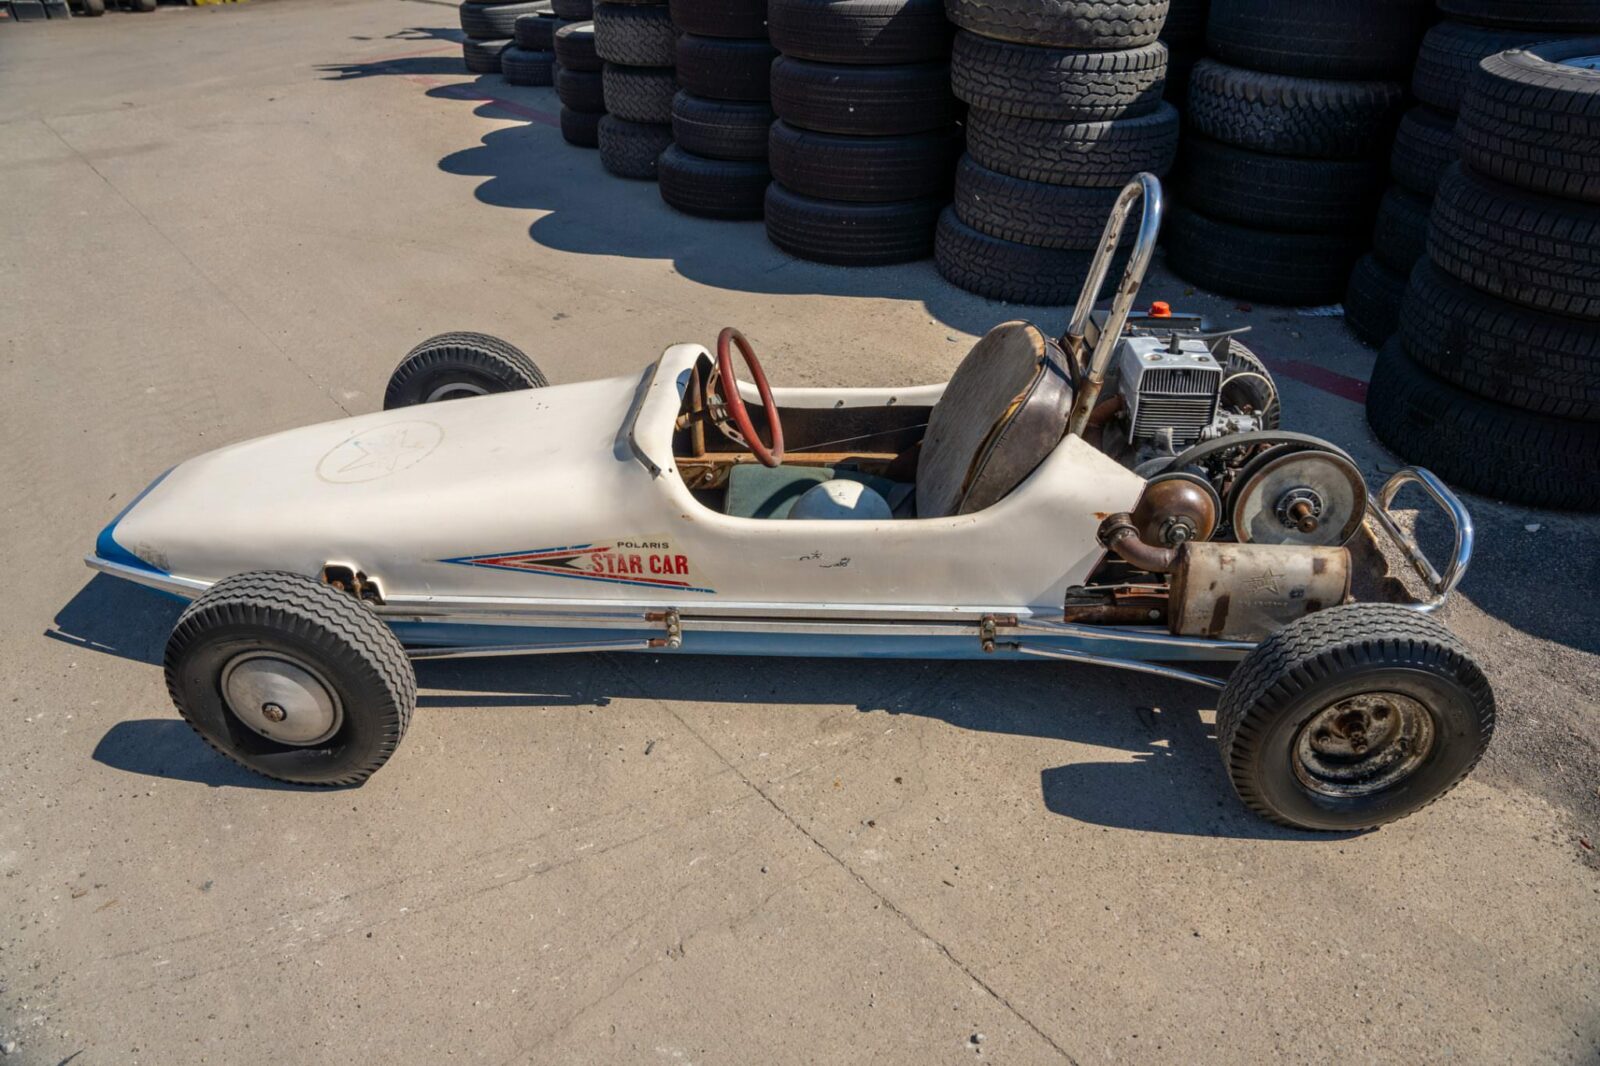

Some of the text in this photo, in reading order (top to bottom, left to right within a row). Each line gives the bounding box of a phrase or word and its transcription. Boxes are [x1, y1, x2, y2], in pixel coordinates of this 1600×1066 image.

[617, 541, 669, 549] POLARIS
[591, 553, 689, 575] STAR CAR
